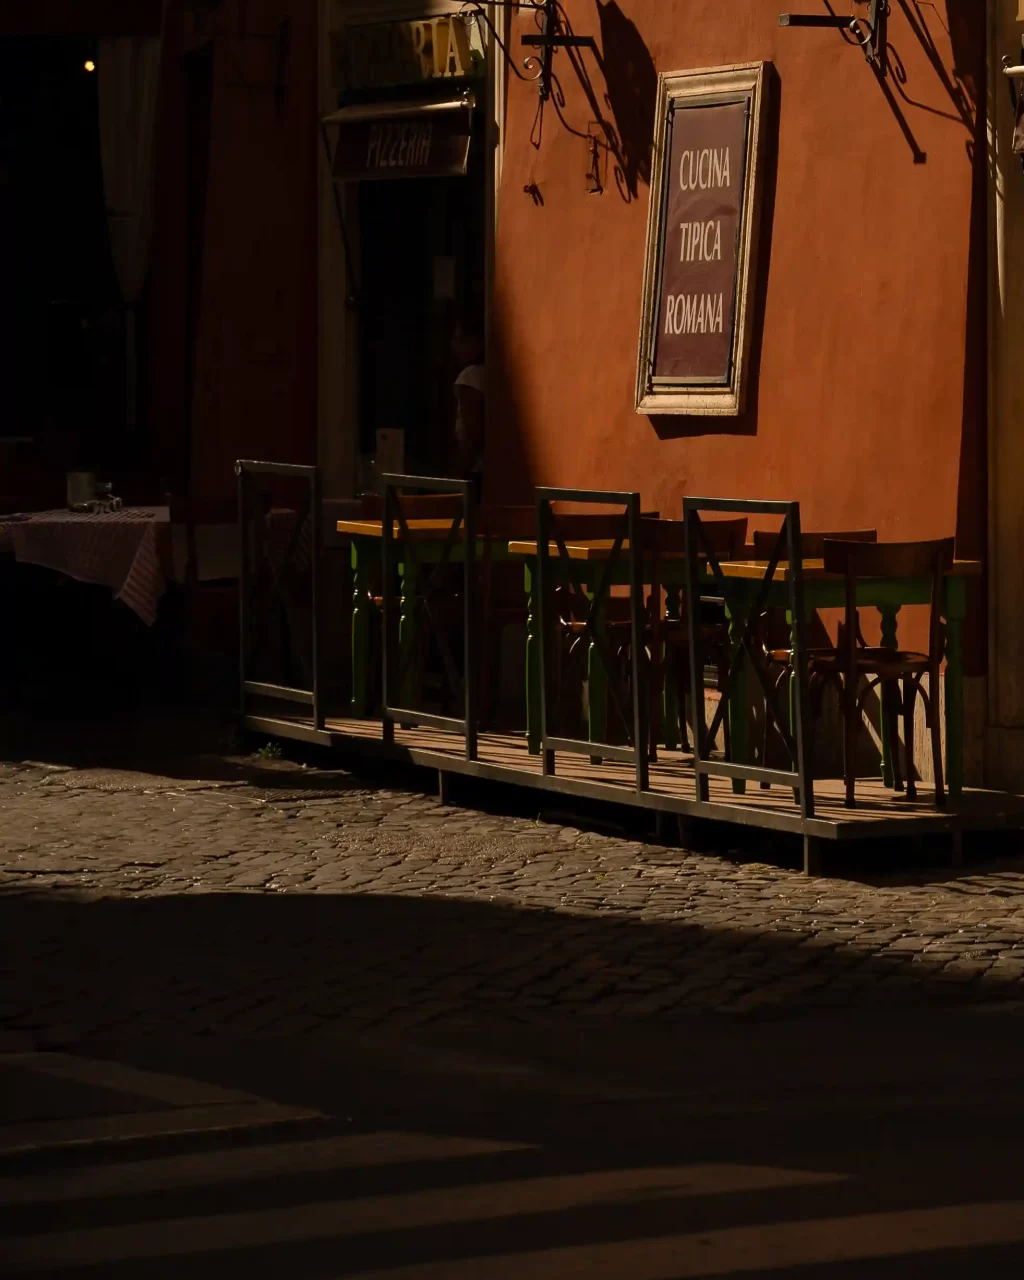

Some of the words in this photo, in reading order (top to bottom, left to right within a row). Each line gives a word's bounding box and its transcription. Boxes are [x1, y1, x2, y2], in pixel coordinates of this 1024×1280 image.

[679, 147, 730, 191] CUCINA
[679, 220, 721, 262] TIPICA
[664, 292, 723, 335] ROMANA
